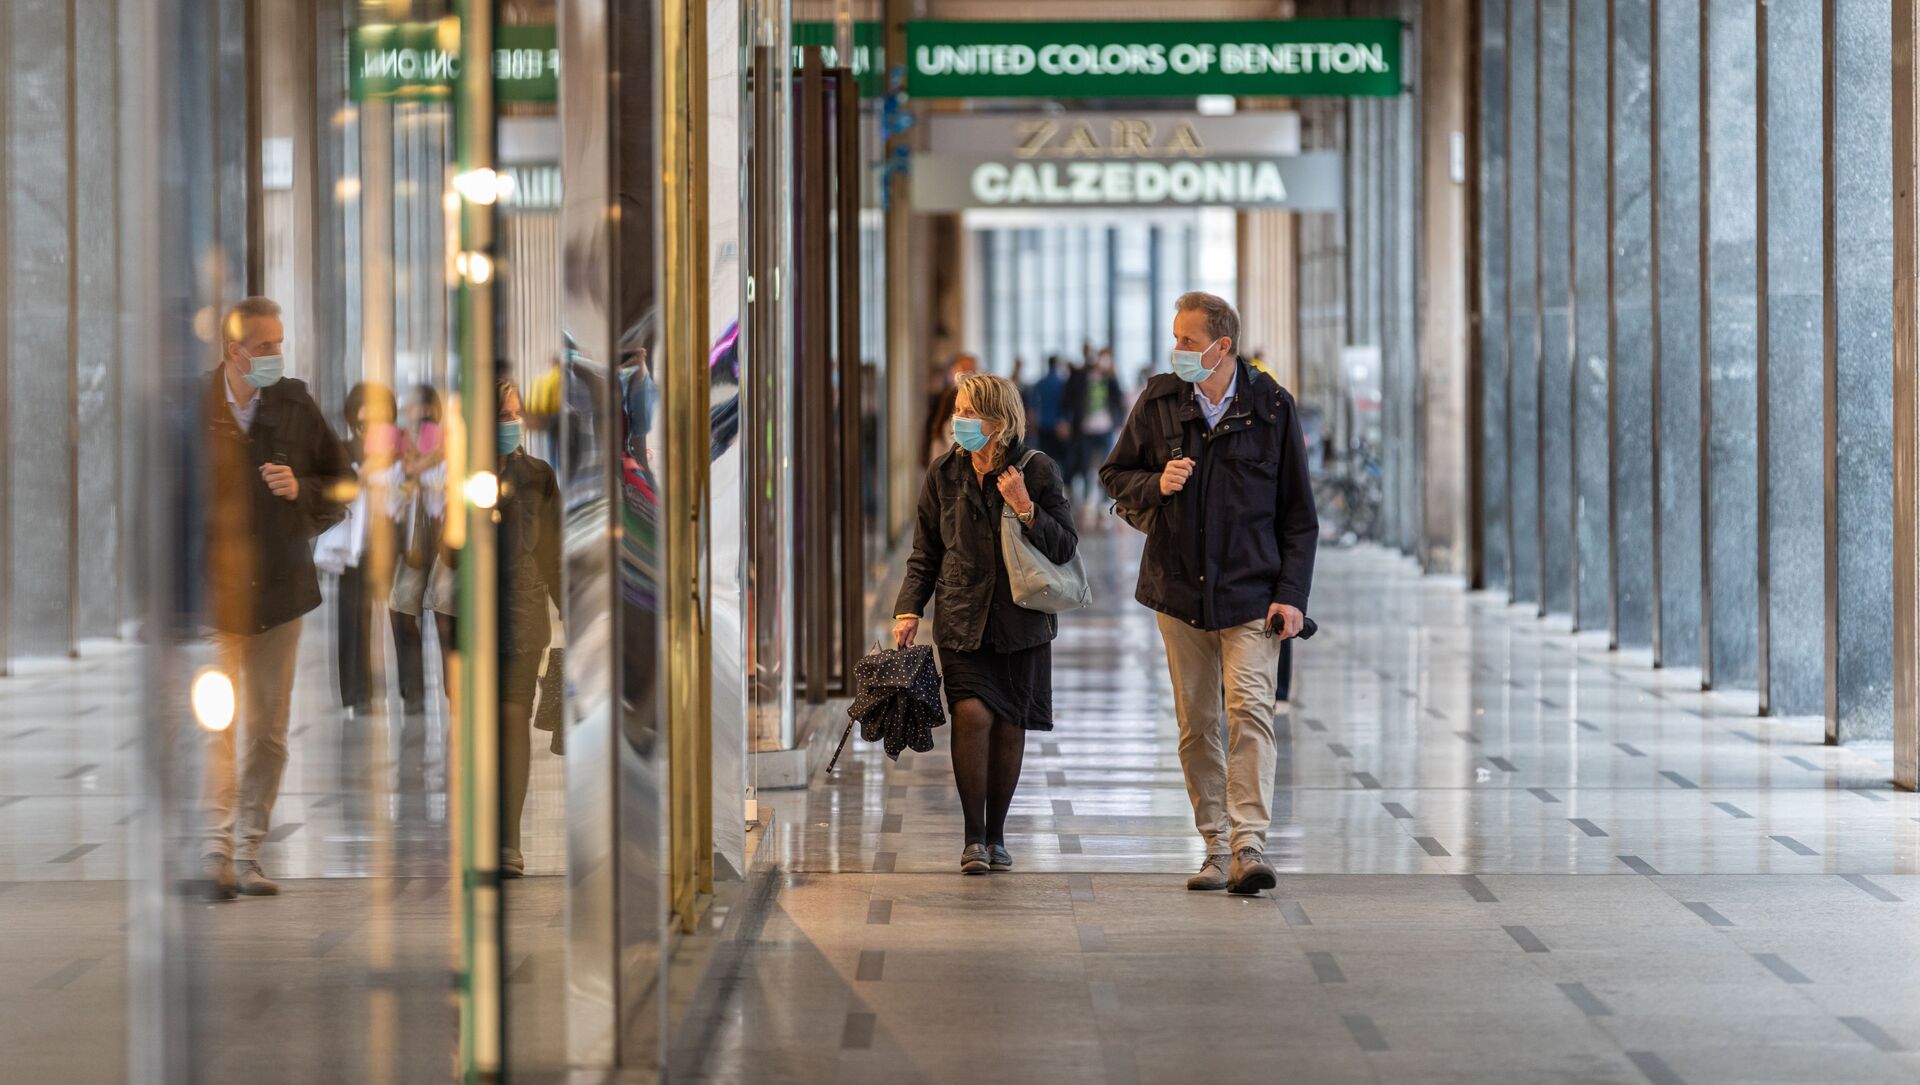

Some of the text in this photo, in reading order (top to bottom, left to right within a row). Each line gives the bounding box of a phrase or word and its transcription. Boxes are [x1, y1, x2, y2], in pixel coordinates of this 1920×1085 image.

[916, 44, 1036, 75] UNITED
[1038, 43, 1167, 75] COLORS
[1169, 43, 1217, 74] OF
[1013, 118, 1206, 158] ZARA
[971, 161, 1287, 203] CALZEDONIA
